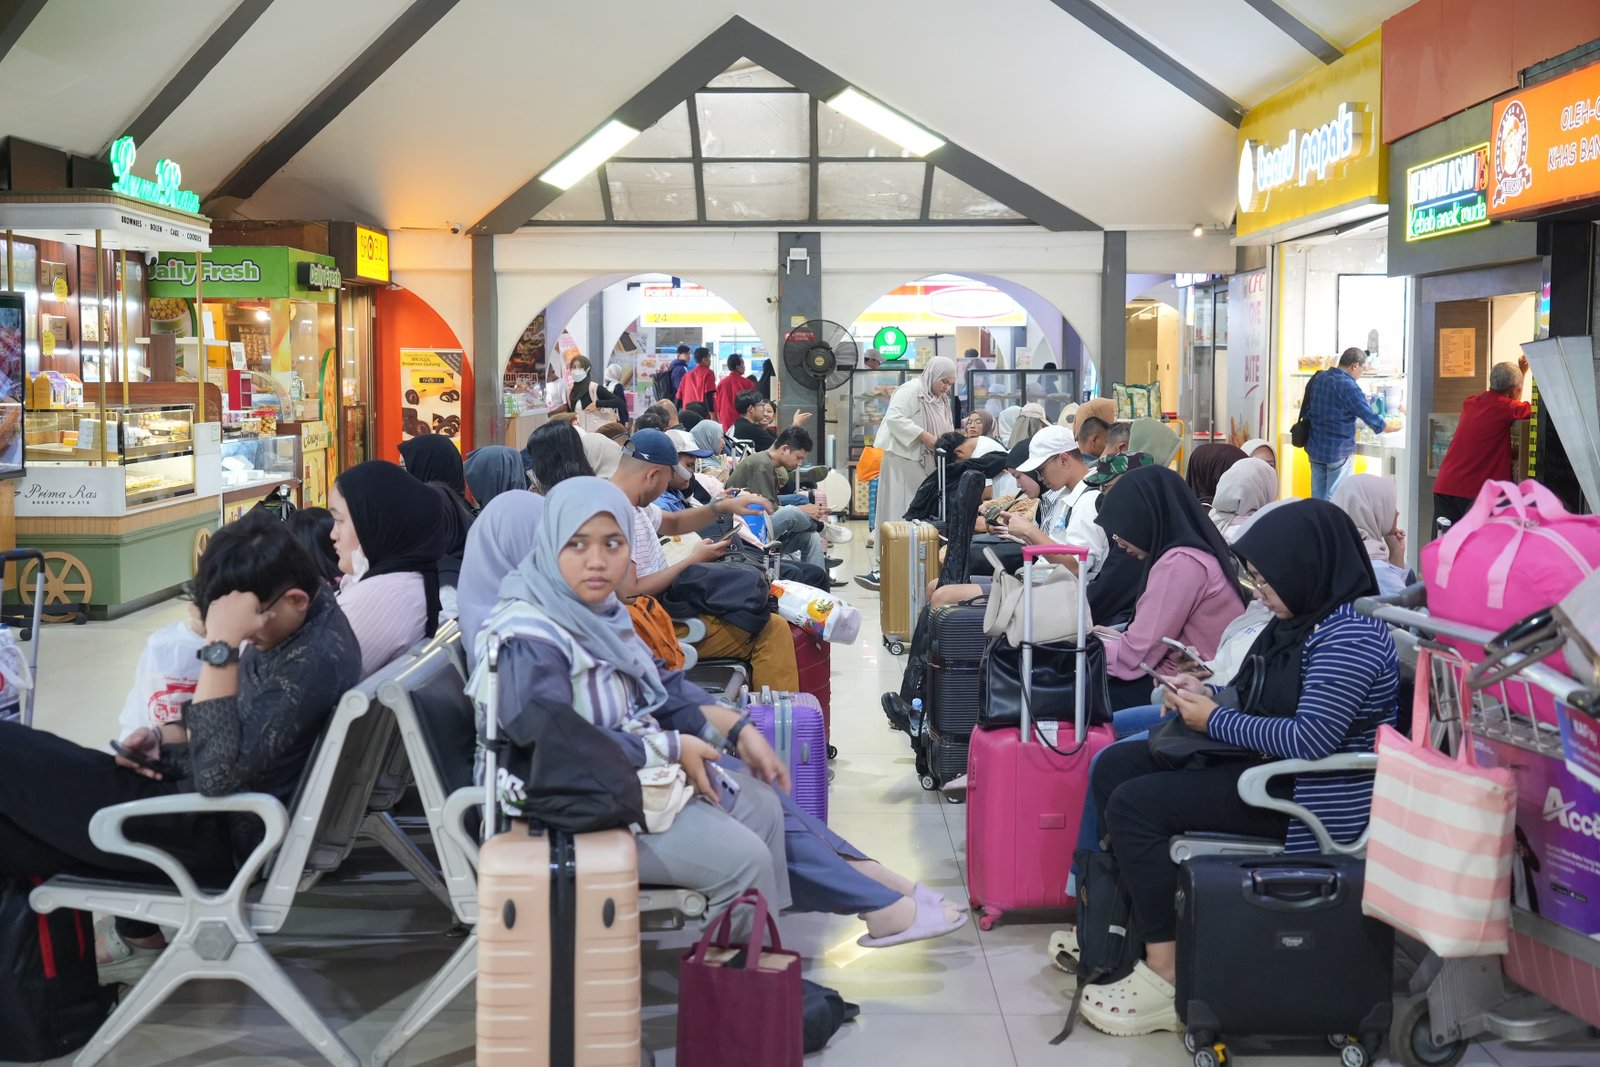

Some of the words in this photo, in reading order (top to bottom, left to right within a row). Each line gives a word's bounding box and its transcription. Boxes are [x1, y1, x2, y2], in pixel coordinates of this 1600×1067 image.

[1257, 128, 1297, 192] beard
[1548, 142, 1577, 172] KHAS
[121, 215, 142, 228] BROWNIES
[200, 260, 260, 282] Fresh
[654, 313, 668, 323] 24
[24, 483, 67, 499] Prima
